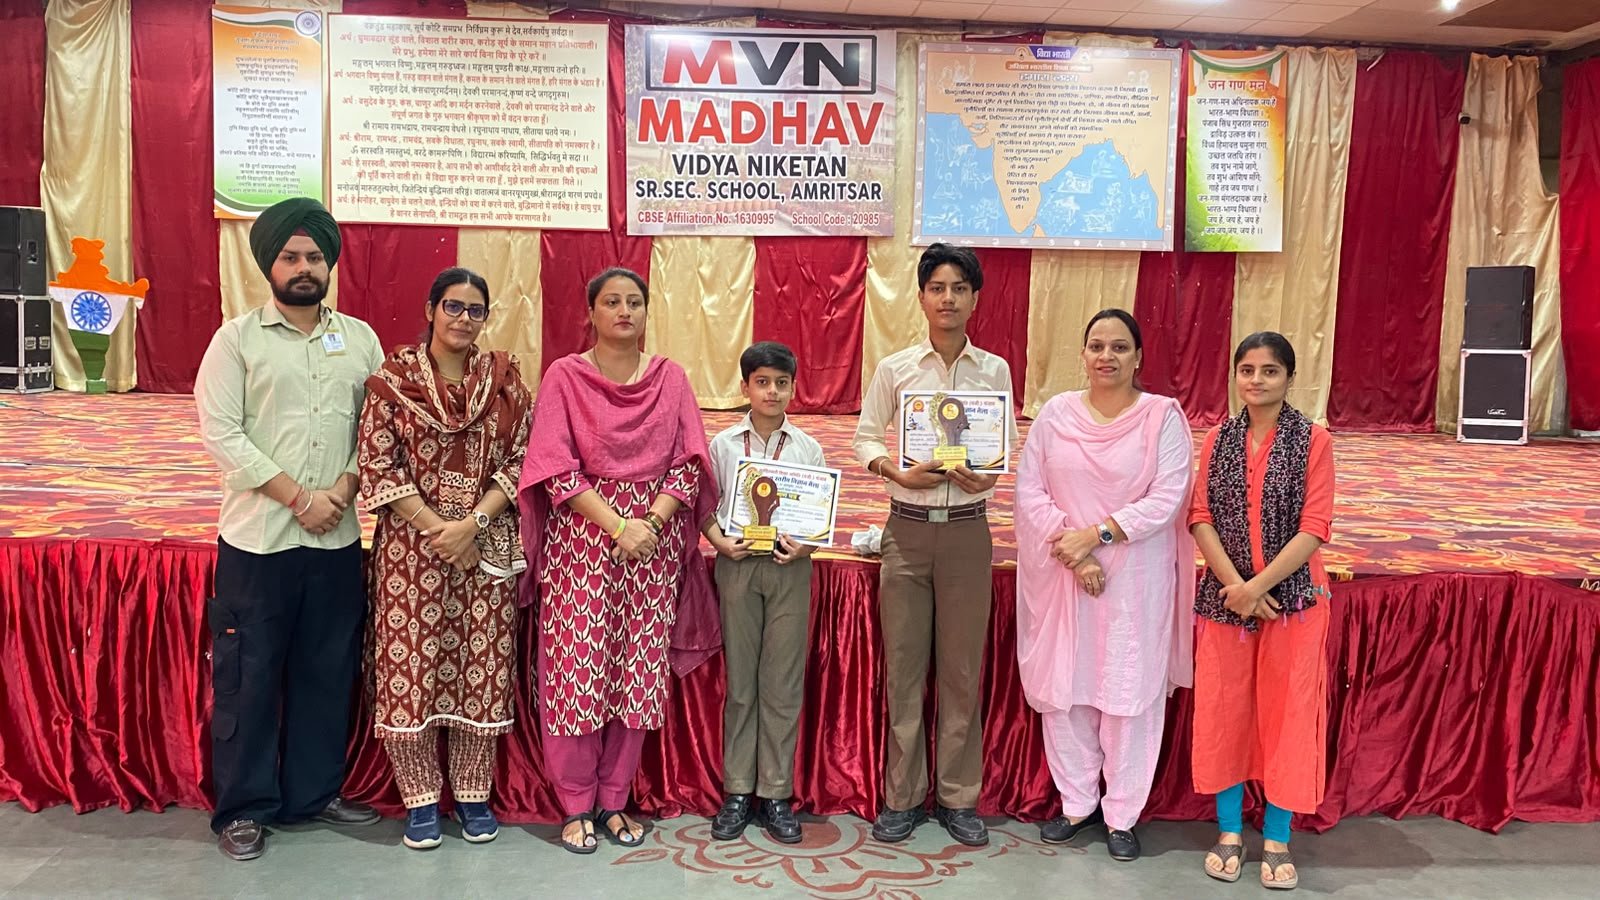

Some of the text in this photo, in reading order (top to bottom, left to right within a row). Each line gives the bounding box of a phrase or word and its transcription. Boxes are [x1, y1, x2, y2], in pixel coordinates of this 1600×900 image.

[1052, 49, 1070, 58] भारती
[663, 40, 860, 86] MVN
[1209, 80, 1265, 90] जन गण मन
[638, 99, 884, 145] MADHAV
[672, 154, 846, 176] VIDYA NIKETAN
[636, 180, 882, 202] SR.SEC. SCHOOL, AMRITSAR
[638, 212, 774, 224] CBSE Affiliation No. 1630995
[793, 213, 821, 224] School
[824, 214, 844, 224] Code
[854, 214, 879, 224] 20985
